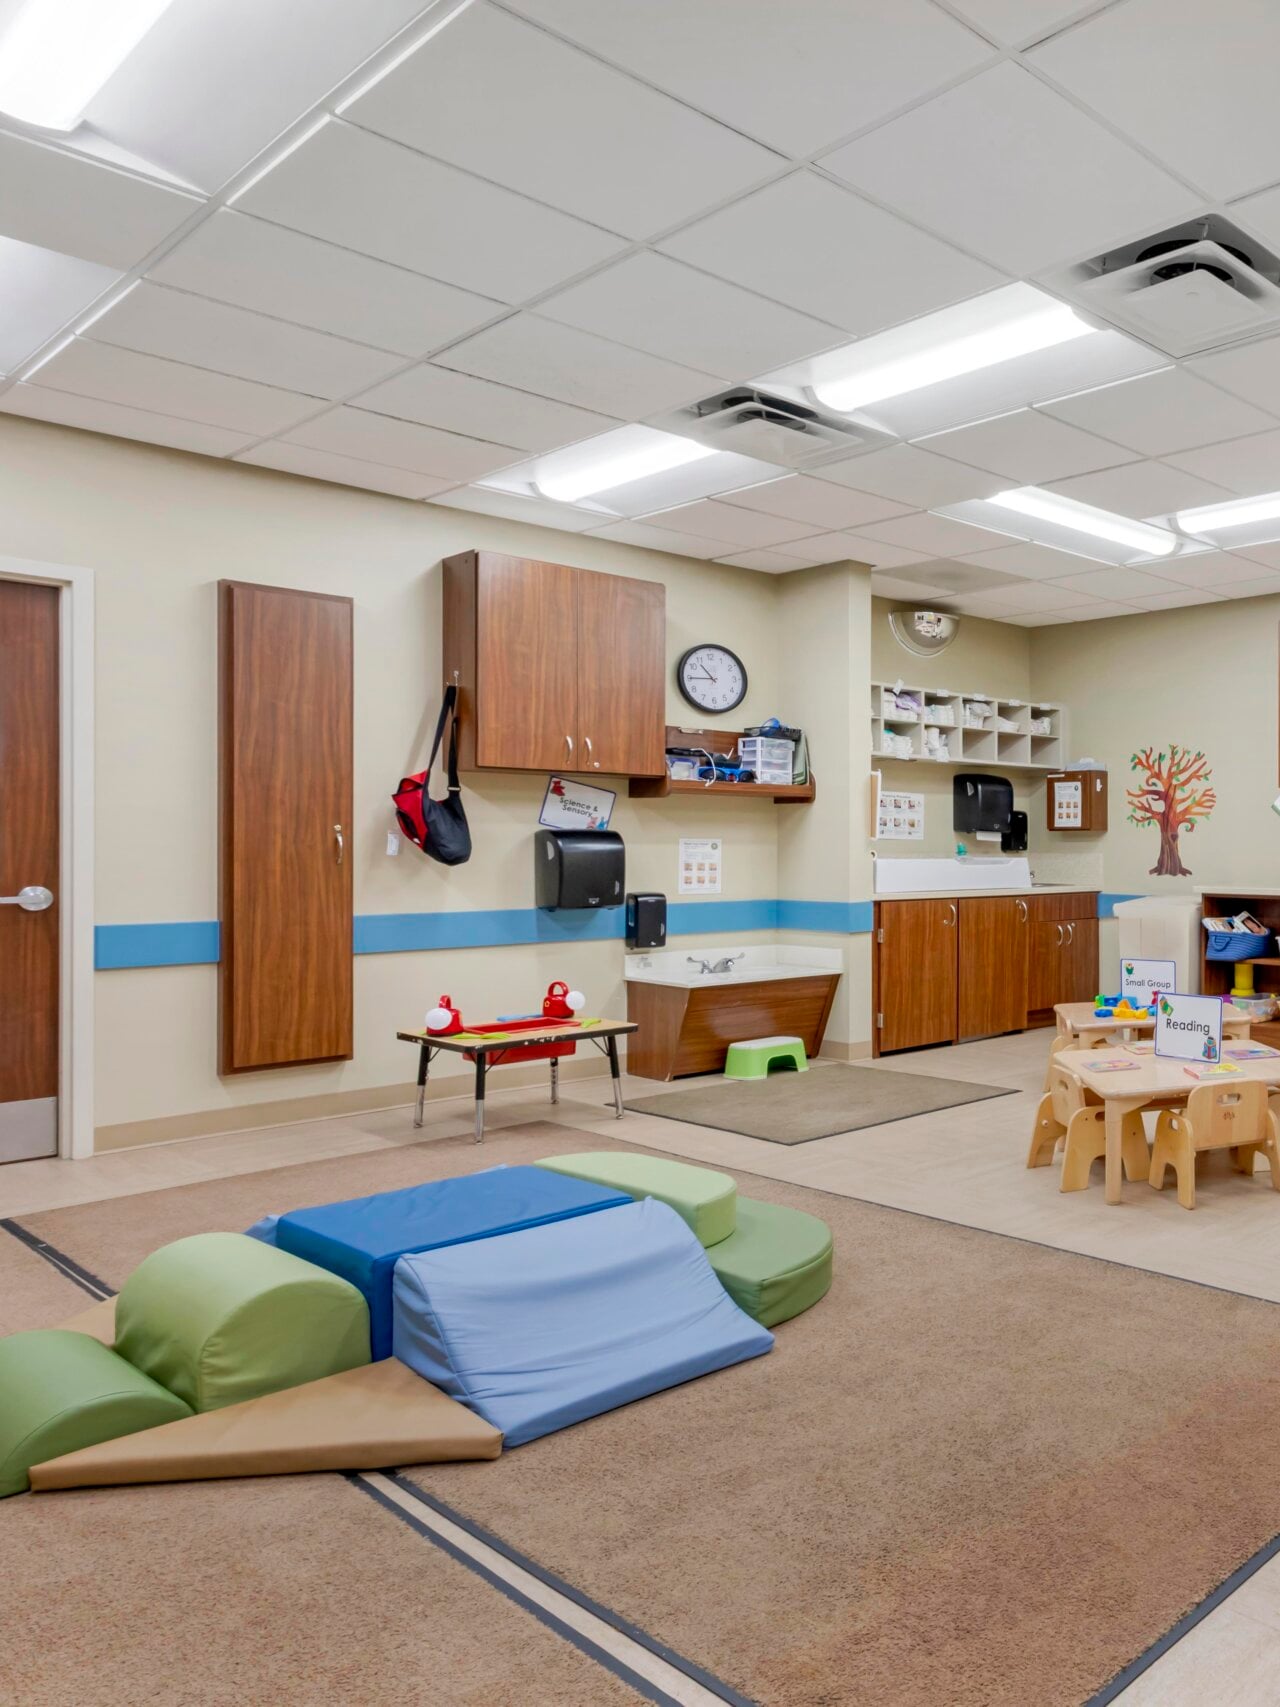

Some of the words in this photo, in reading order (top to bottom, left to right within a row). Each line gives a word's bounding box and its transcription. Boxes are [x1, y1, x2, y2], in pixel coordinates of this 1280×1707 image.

[696, 656, 703, 664] 11
[706, 653, 714, 661] 12
[689, 663, 697, 671] 10
[728, 664, 733, 672] 2
[691, 685, 697, 693] 8
[711, 696, 717, 704] 6
[560, 797, 591, 810] Science
[562, 804, 592, 817] Sensory
[1125, 979, 1145, 987] Small
[1147, 980, 1171, 989] Group
[1166, 1018, 1210, 1035] Reading
